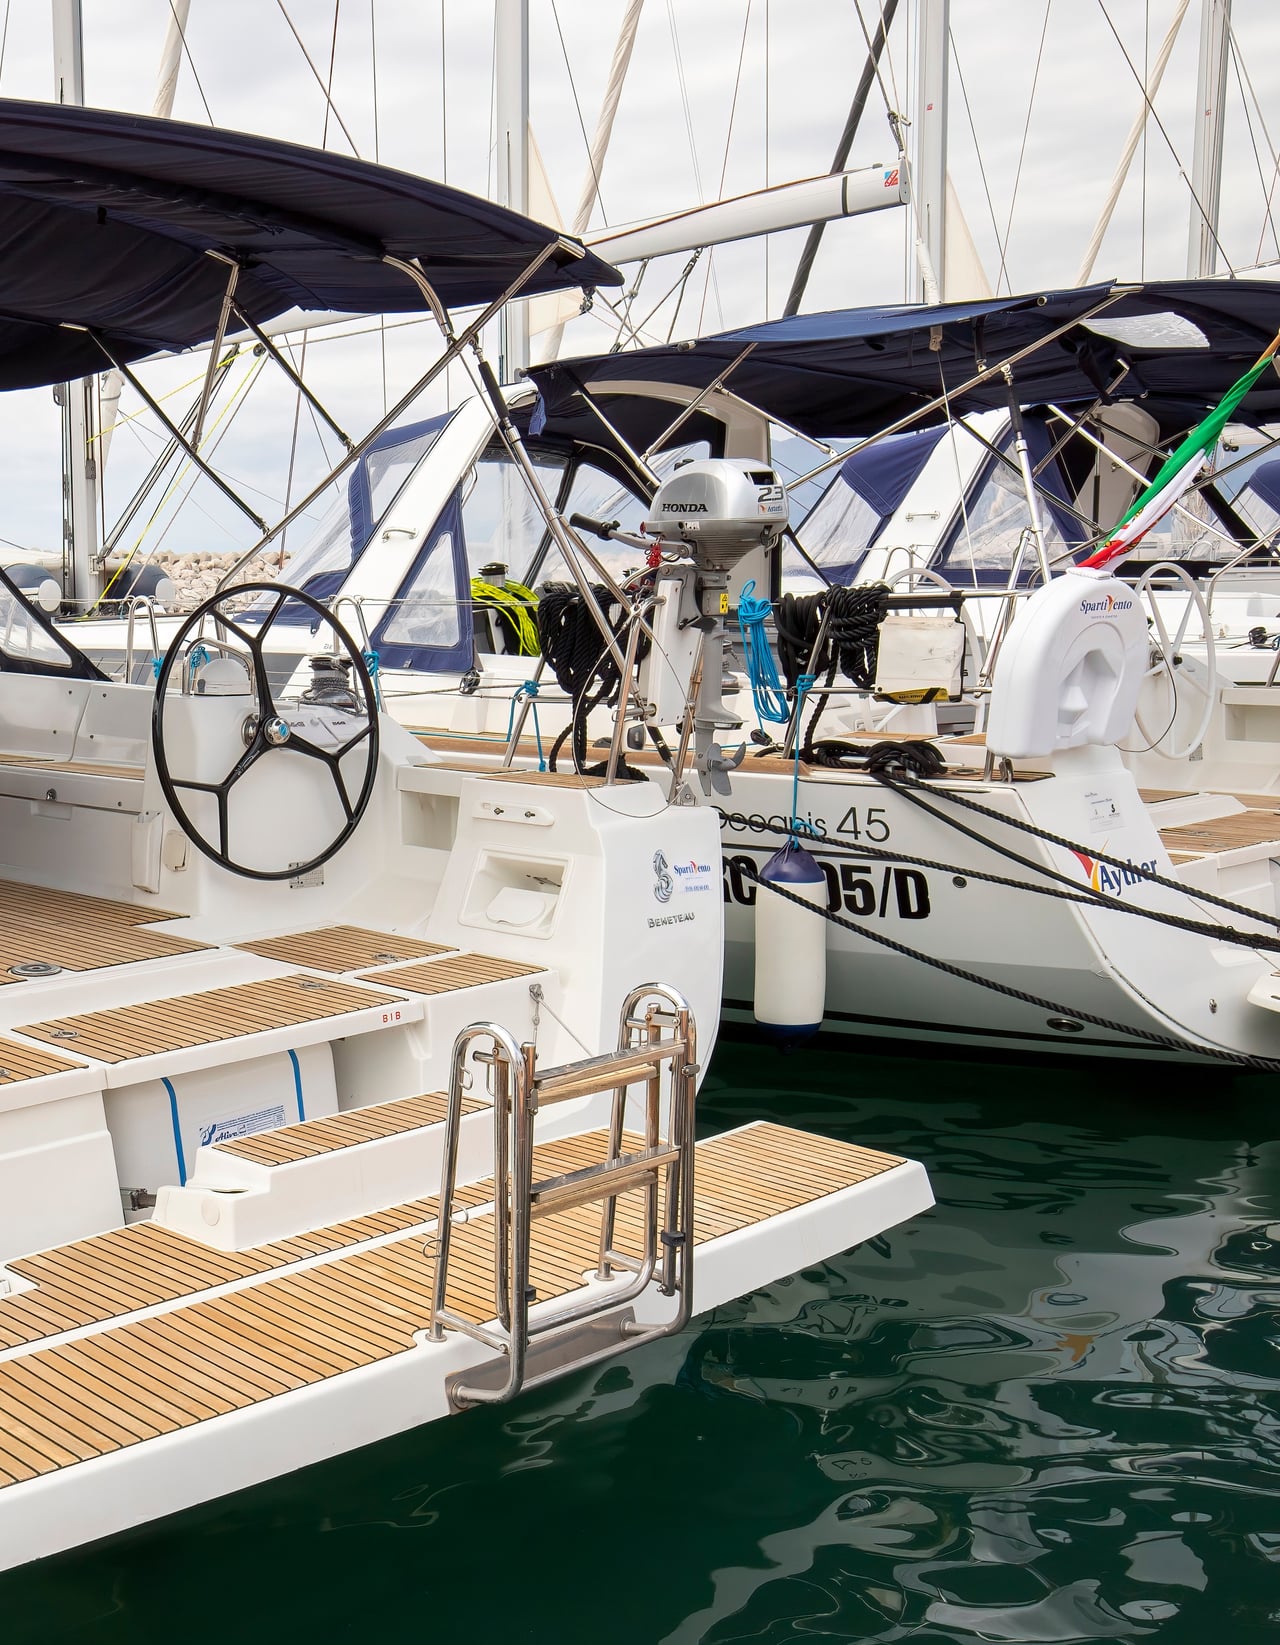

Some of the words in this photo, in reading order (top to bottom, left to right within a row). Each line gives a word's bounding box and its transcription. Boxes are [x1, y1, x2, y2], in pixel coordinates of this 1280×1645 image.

[661, 503, 709, 513] HONDA
[836, 807, 891, 843] 45
[647, 912, 696, 928] BENETEAU
